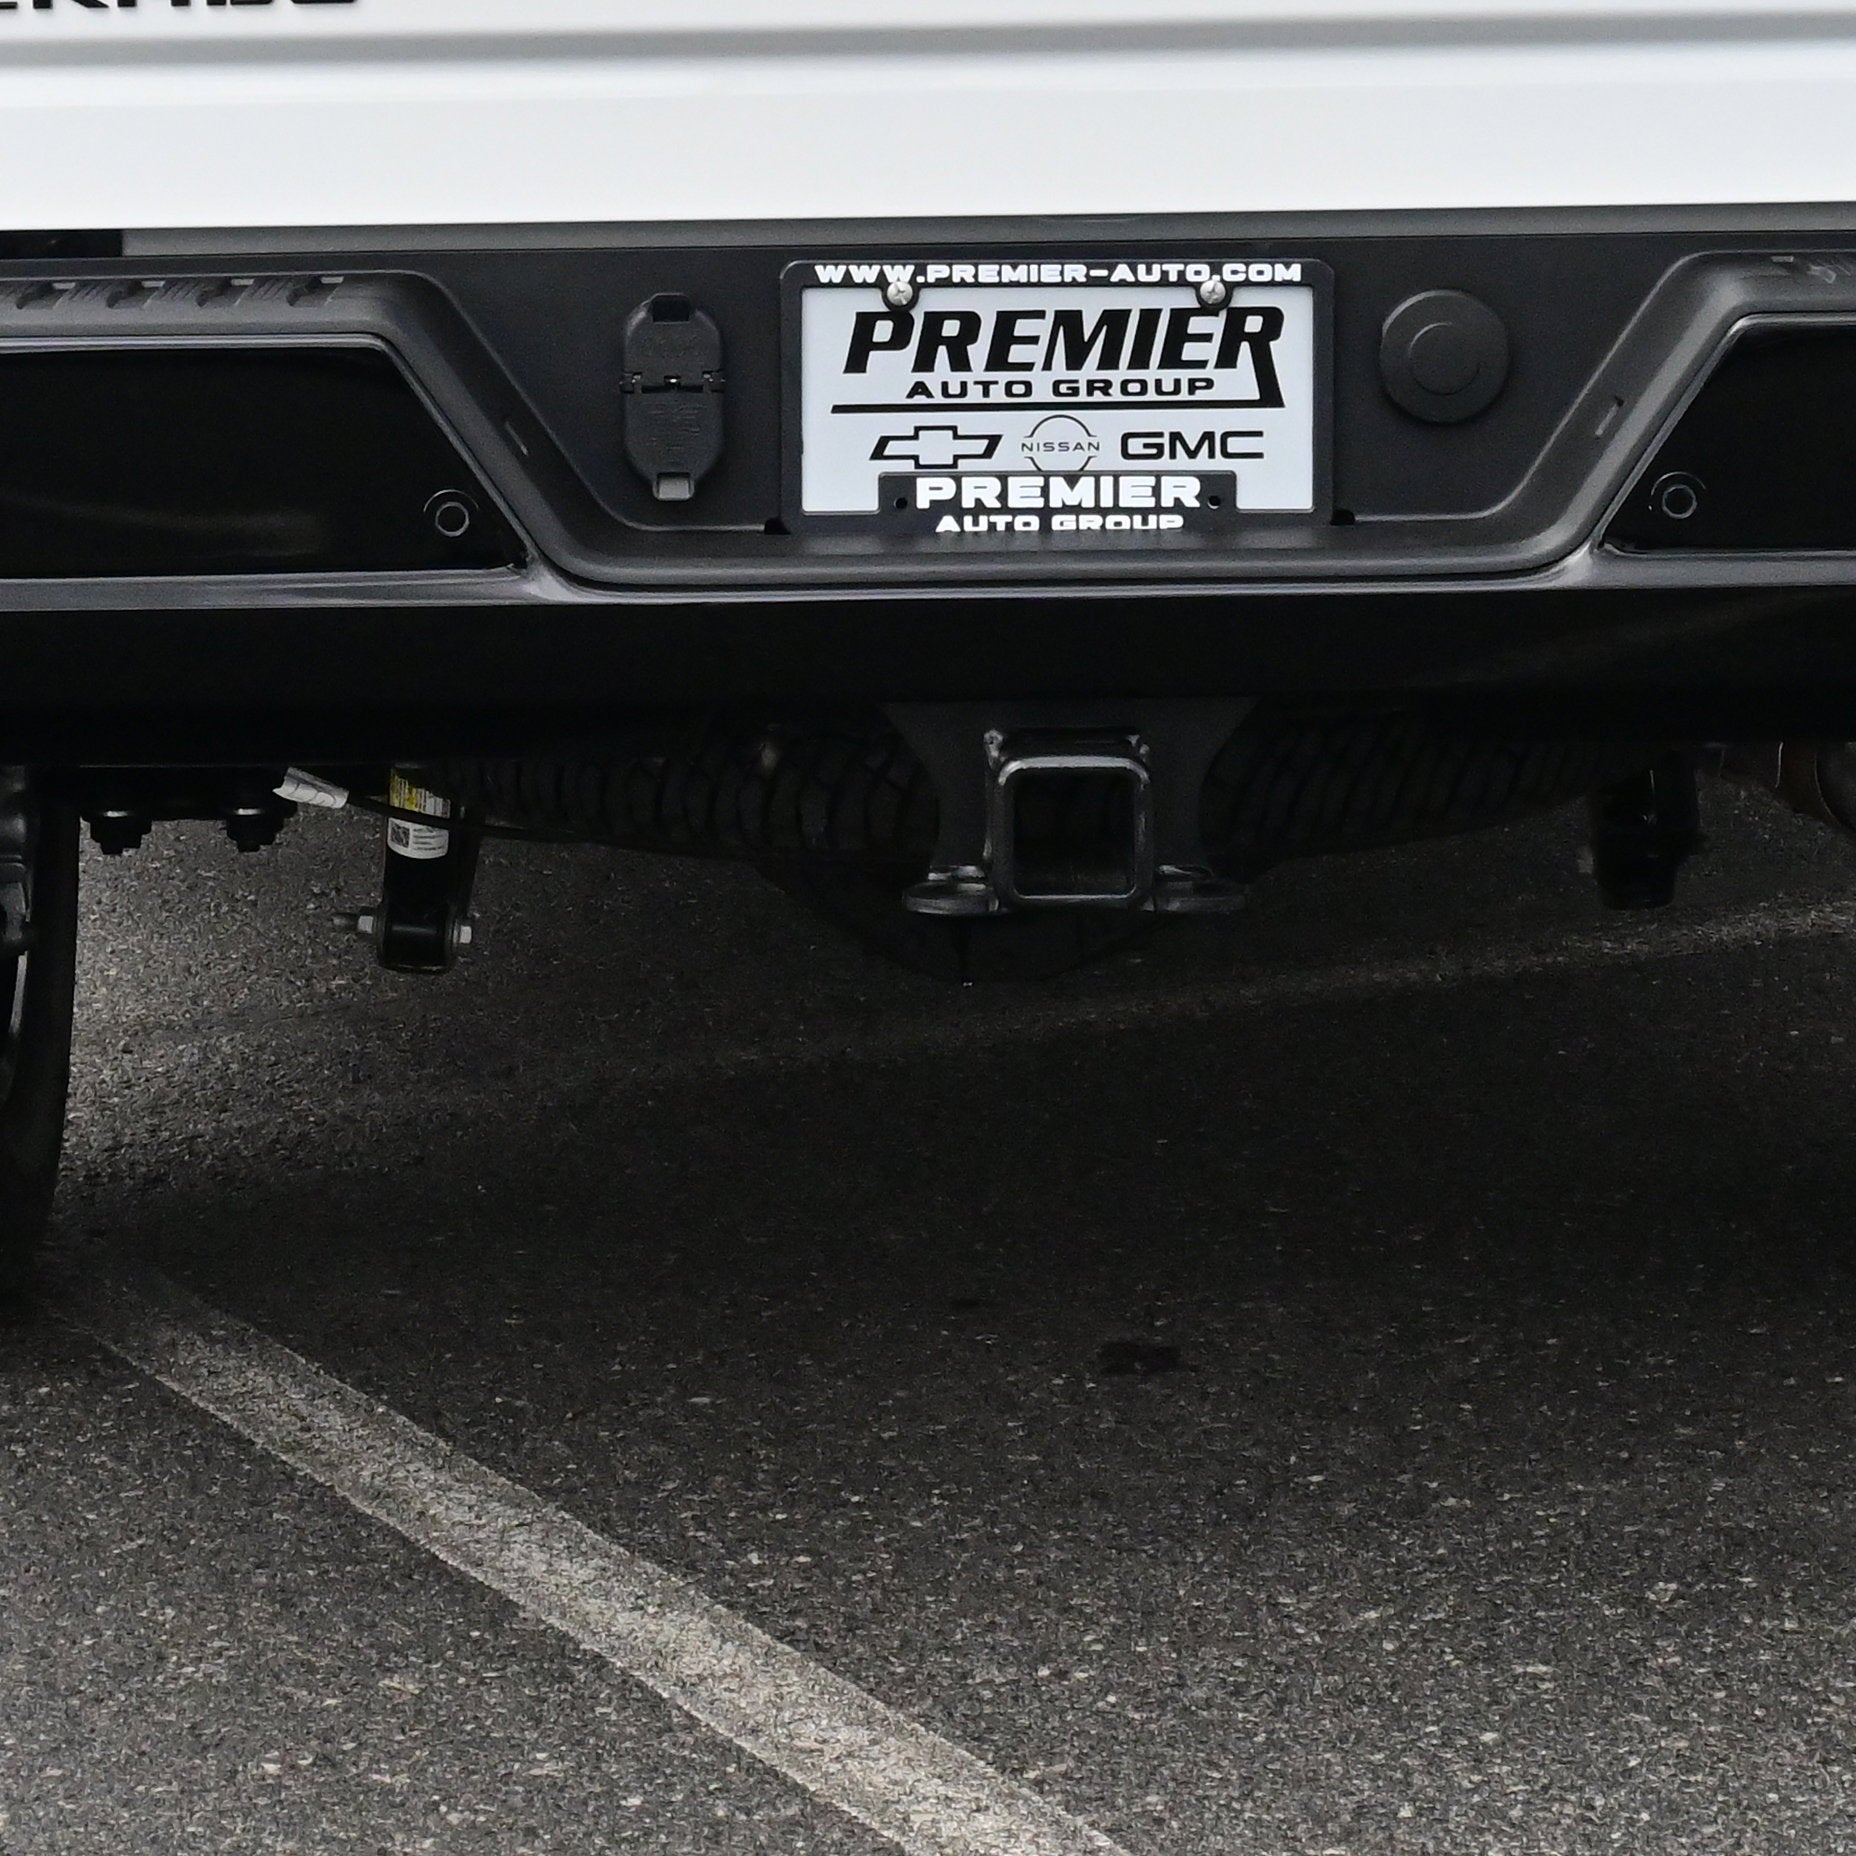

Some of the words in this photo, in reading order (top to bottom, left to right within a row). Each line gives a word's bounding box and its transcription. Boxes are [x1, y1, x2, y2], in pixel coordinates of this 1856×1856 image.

[814, 263, 1302, 284] WWW.PREMIER-AUTO.COM
[843, 306, 1285, 374] PREMIER
[905, 379, 1032, 399] AUTO
[1051, 377, 1215, 398] GROUP
[1021, 441, 1100, 452] NISSAN
[1120, 430, 1264, 460] GMC
[916, 475, 1200, 510] PREMIER
[935, 515, 1040, 533] AUTO
[1051, 514, 1184, 531] GROUP
